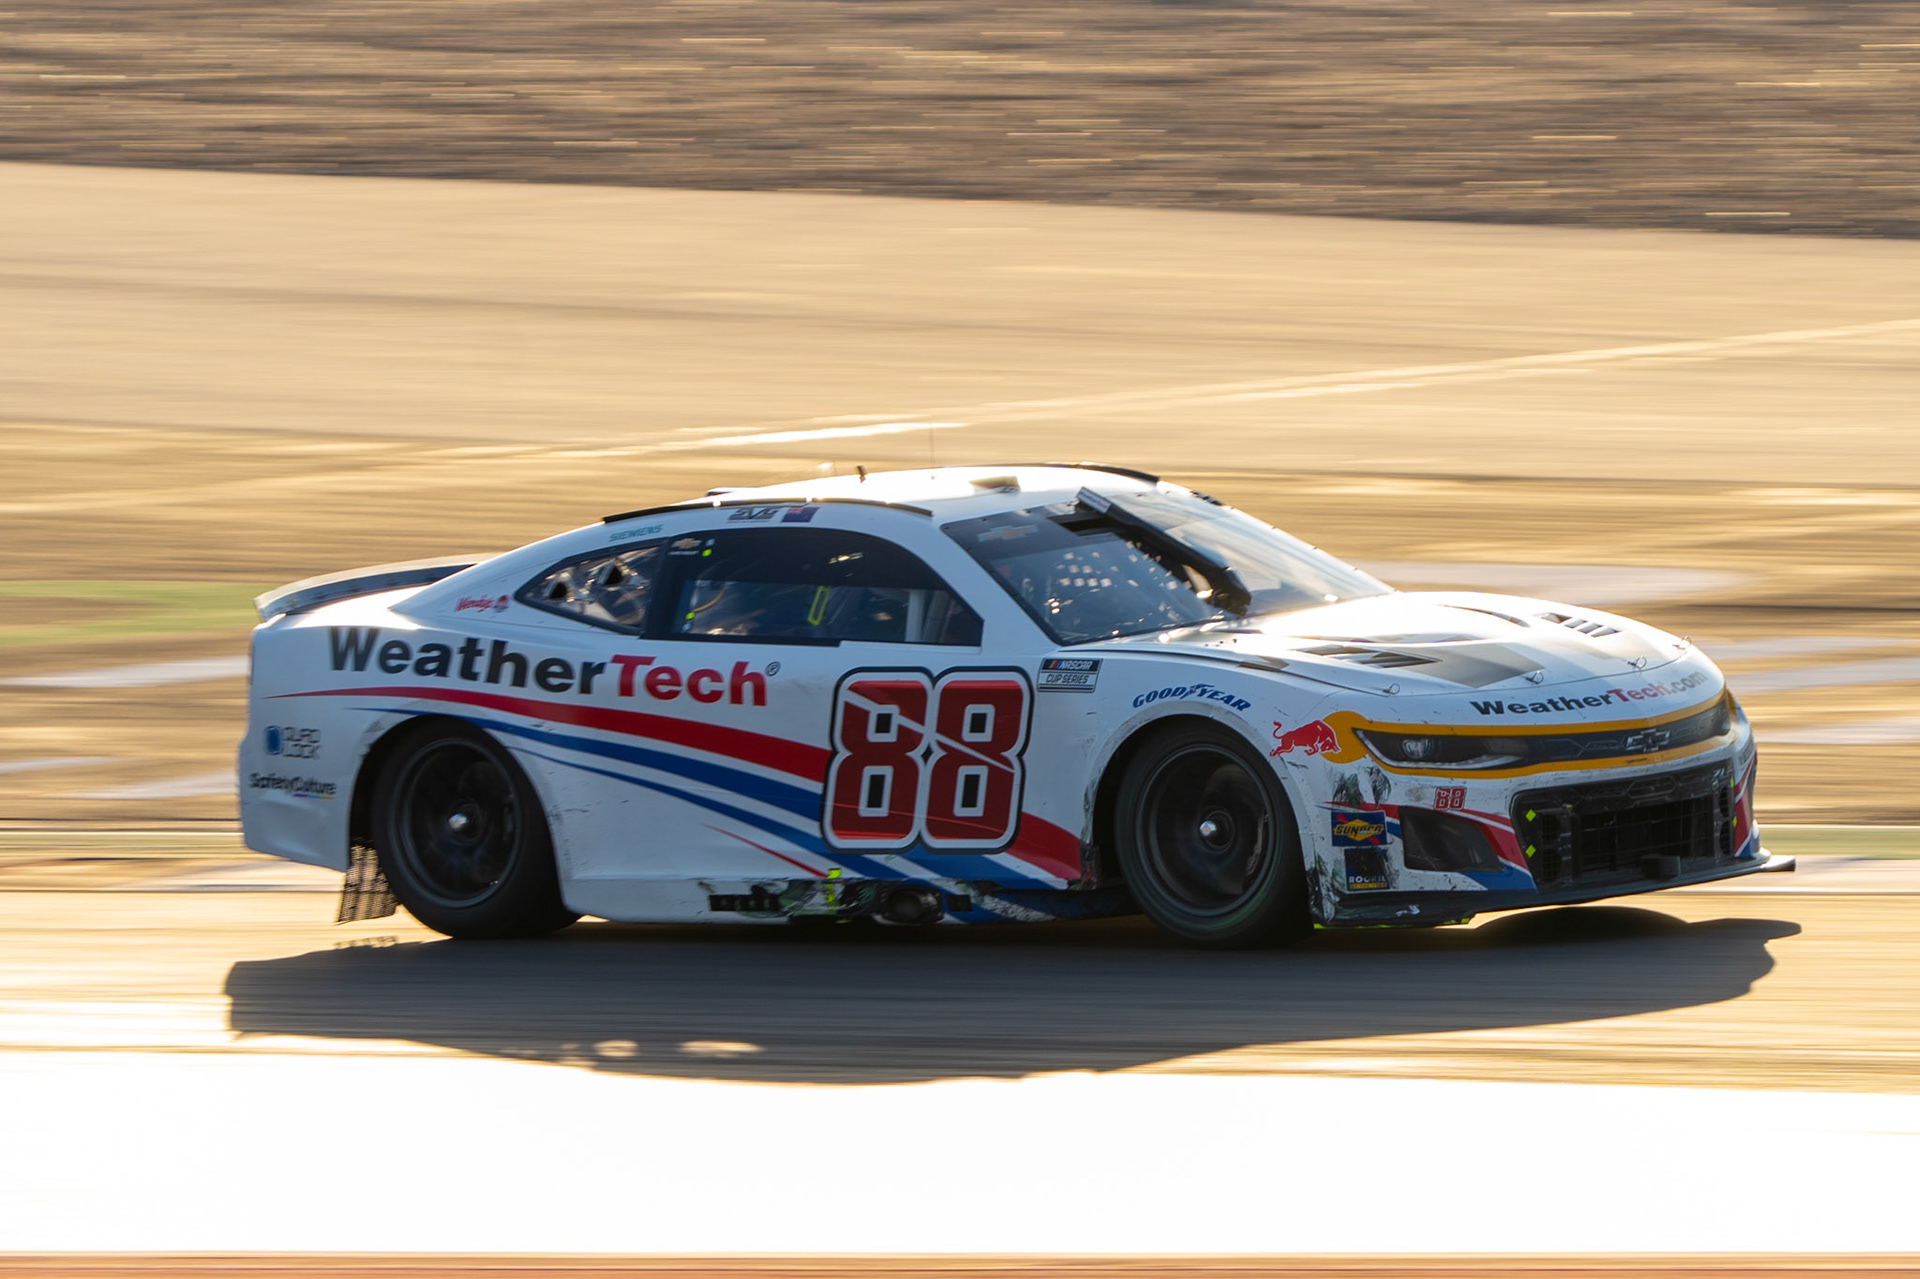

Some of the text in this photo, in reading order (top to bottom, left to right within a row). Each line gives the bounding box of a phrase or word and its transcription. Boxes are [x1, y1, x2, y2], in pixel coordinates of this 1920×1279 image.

[609, 524, 664, 542] SIEMENS
[1058, 660, 1093, 671] NASCAR
[1046, 674, 1090, 685] CUP SERIES
[1470, 670, 1709, 716] WeatherTech.com
[821, 667, 1034, 854] 88
[1434, 786, 1466, 810] 88
[1335, 823, 1383, 838] SUNOCO
